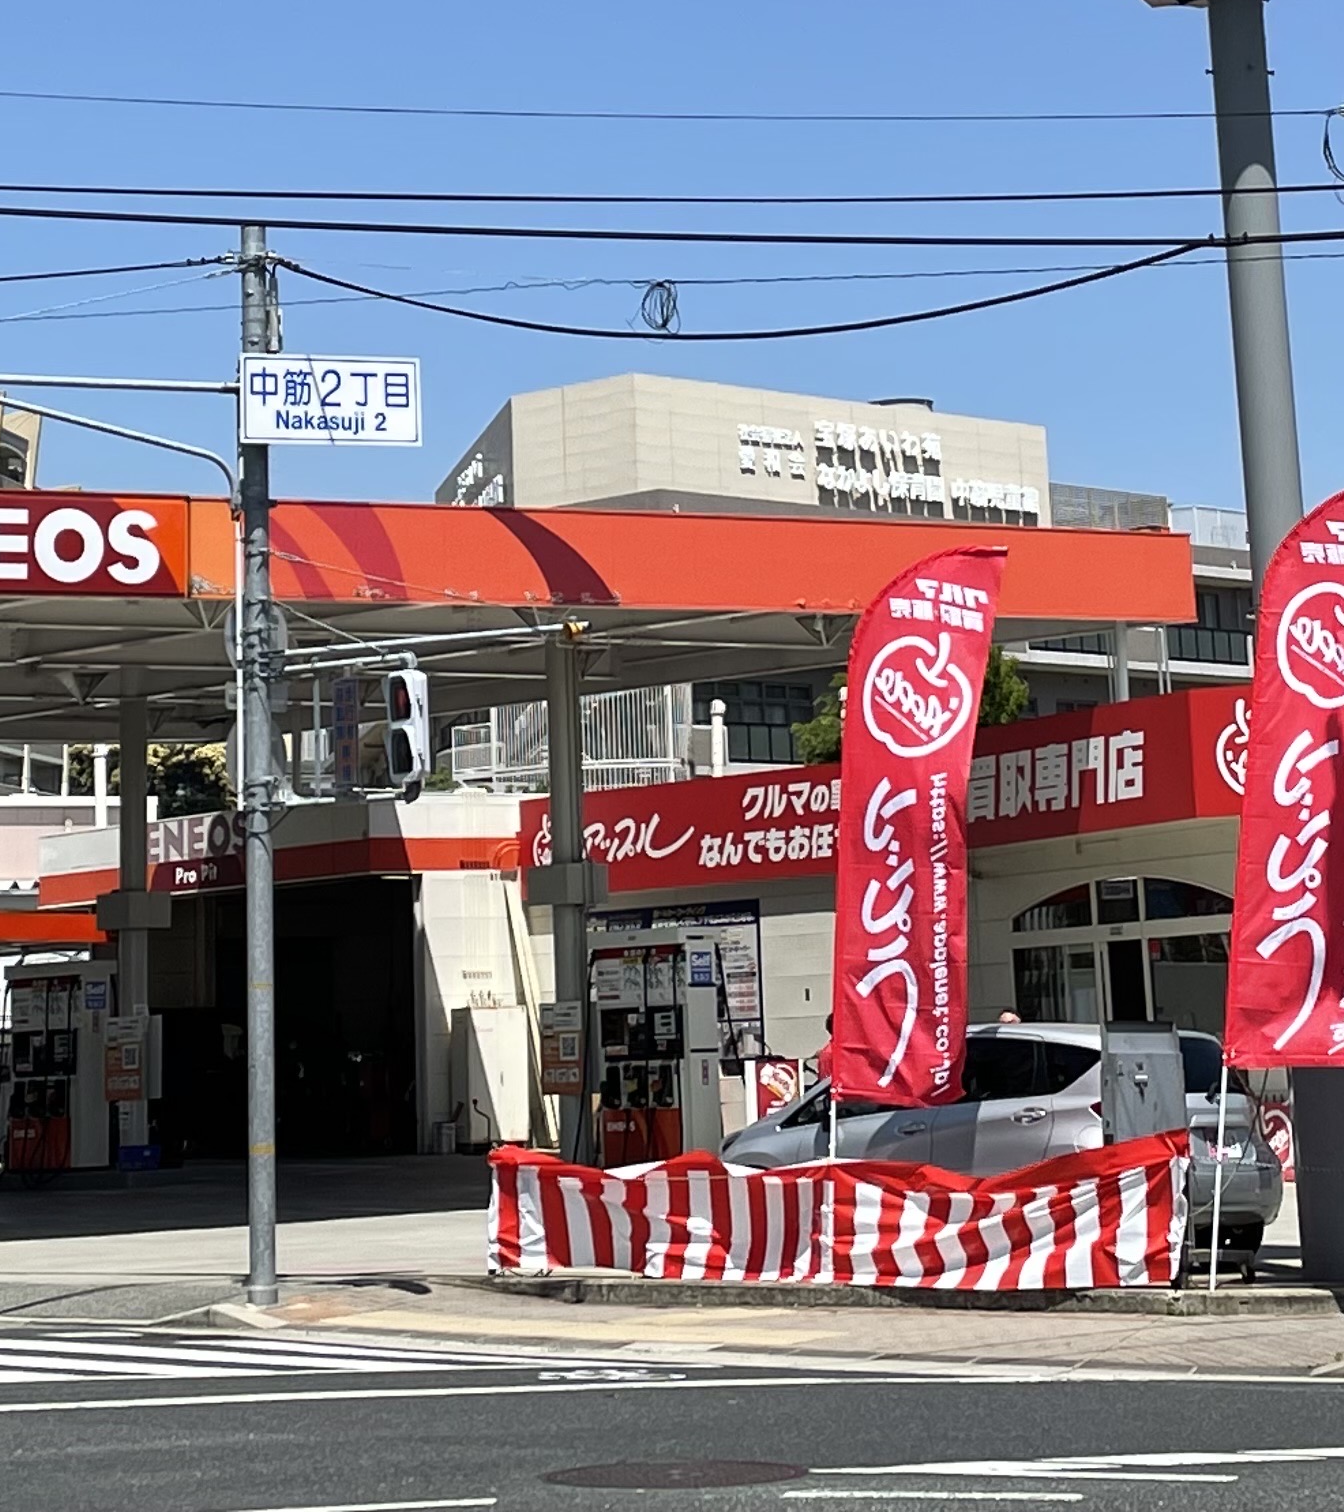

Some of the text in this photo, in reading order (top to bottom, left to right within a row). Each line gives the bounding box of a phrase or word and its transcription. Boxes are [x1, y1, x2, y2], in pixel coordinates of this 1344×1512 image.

[250, 366, 410, 408] 中筋2丁目
[275, 409, 387, 435] Nakasuji 2
[699, 822, 840, 868] なんでもお任
[175, 866, 197, 885] Pro
